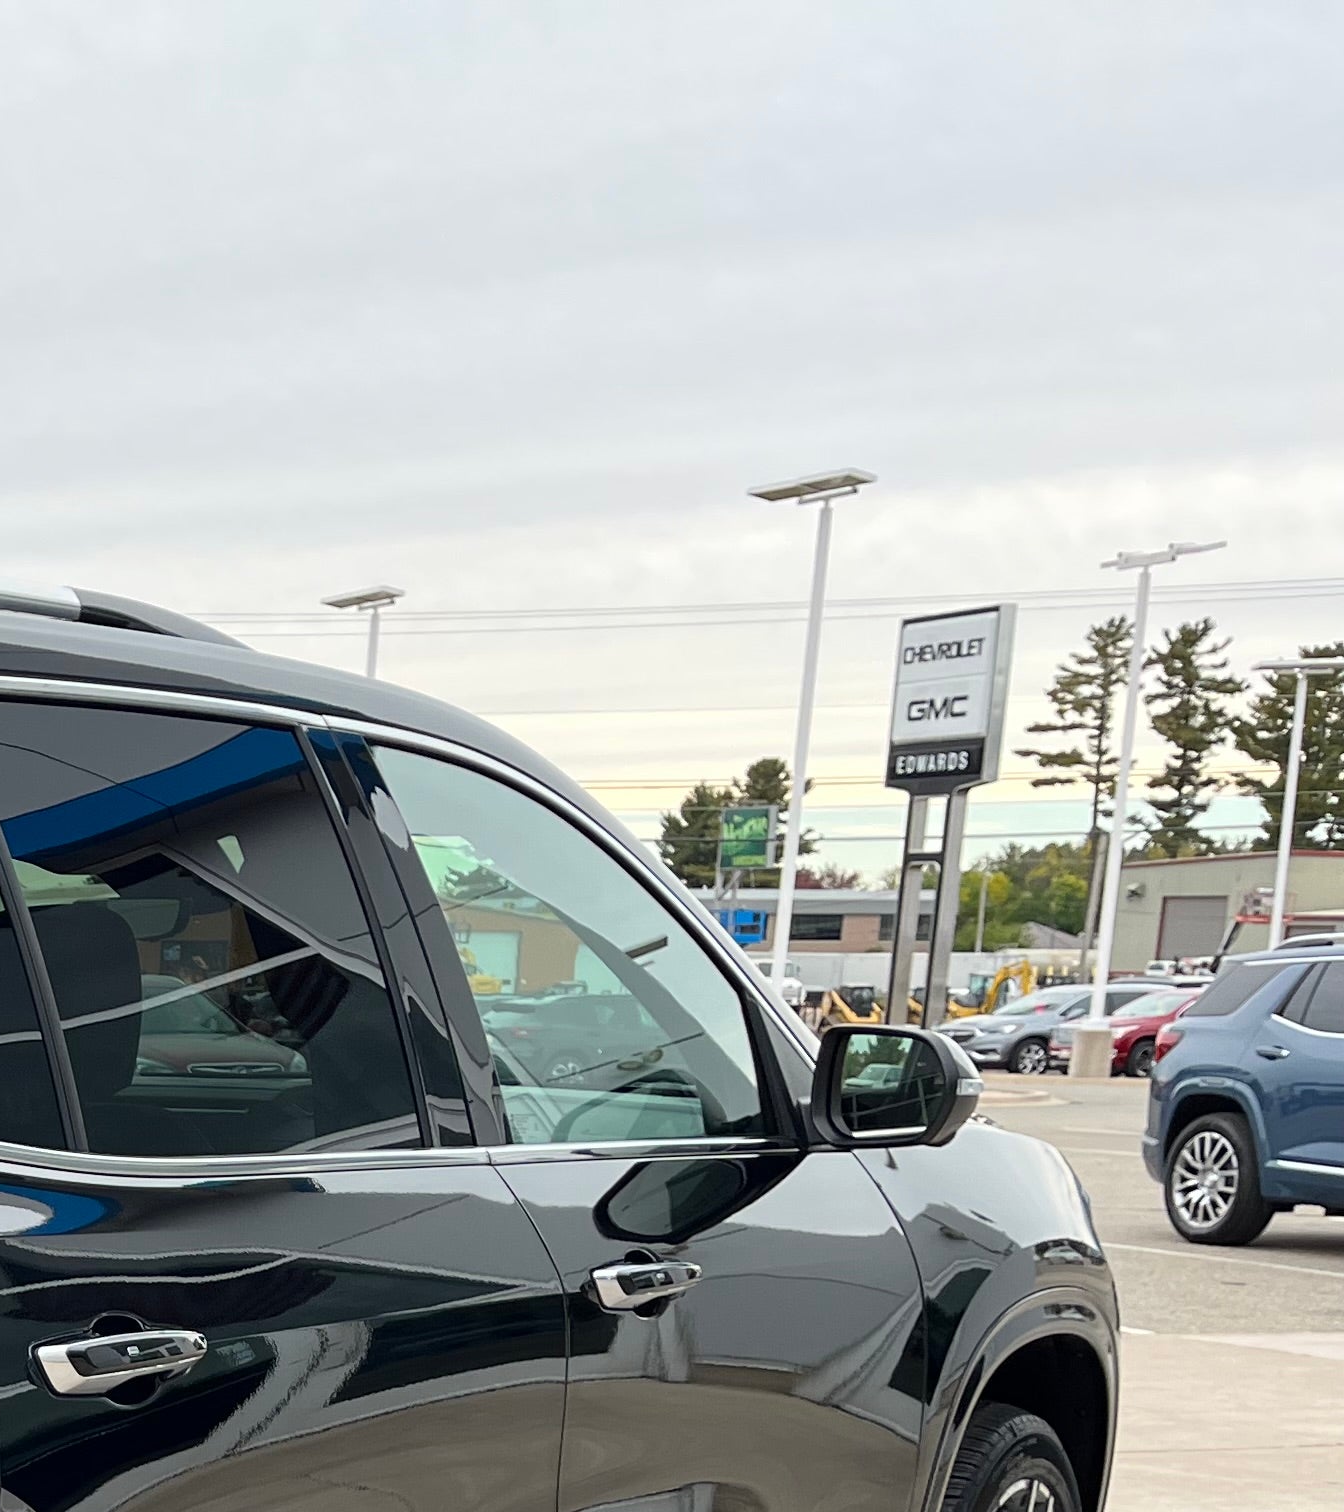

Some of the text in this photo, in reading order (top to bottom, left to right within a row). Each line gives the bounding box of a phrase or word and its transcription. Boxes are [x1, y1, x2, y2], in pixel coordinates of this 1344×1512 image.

[903, 637, 986, 665] CHEVROLET
[907, 694, 969, 721] GMC
[895, 750, 969, 775] EDWARDS
